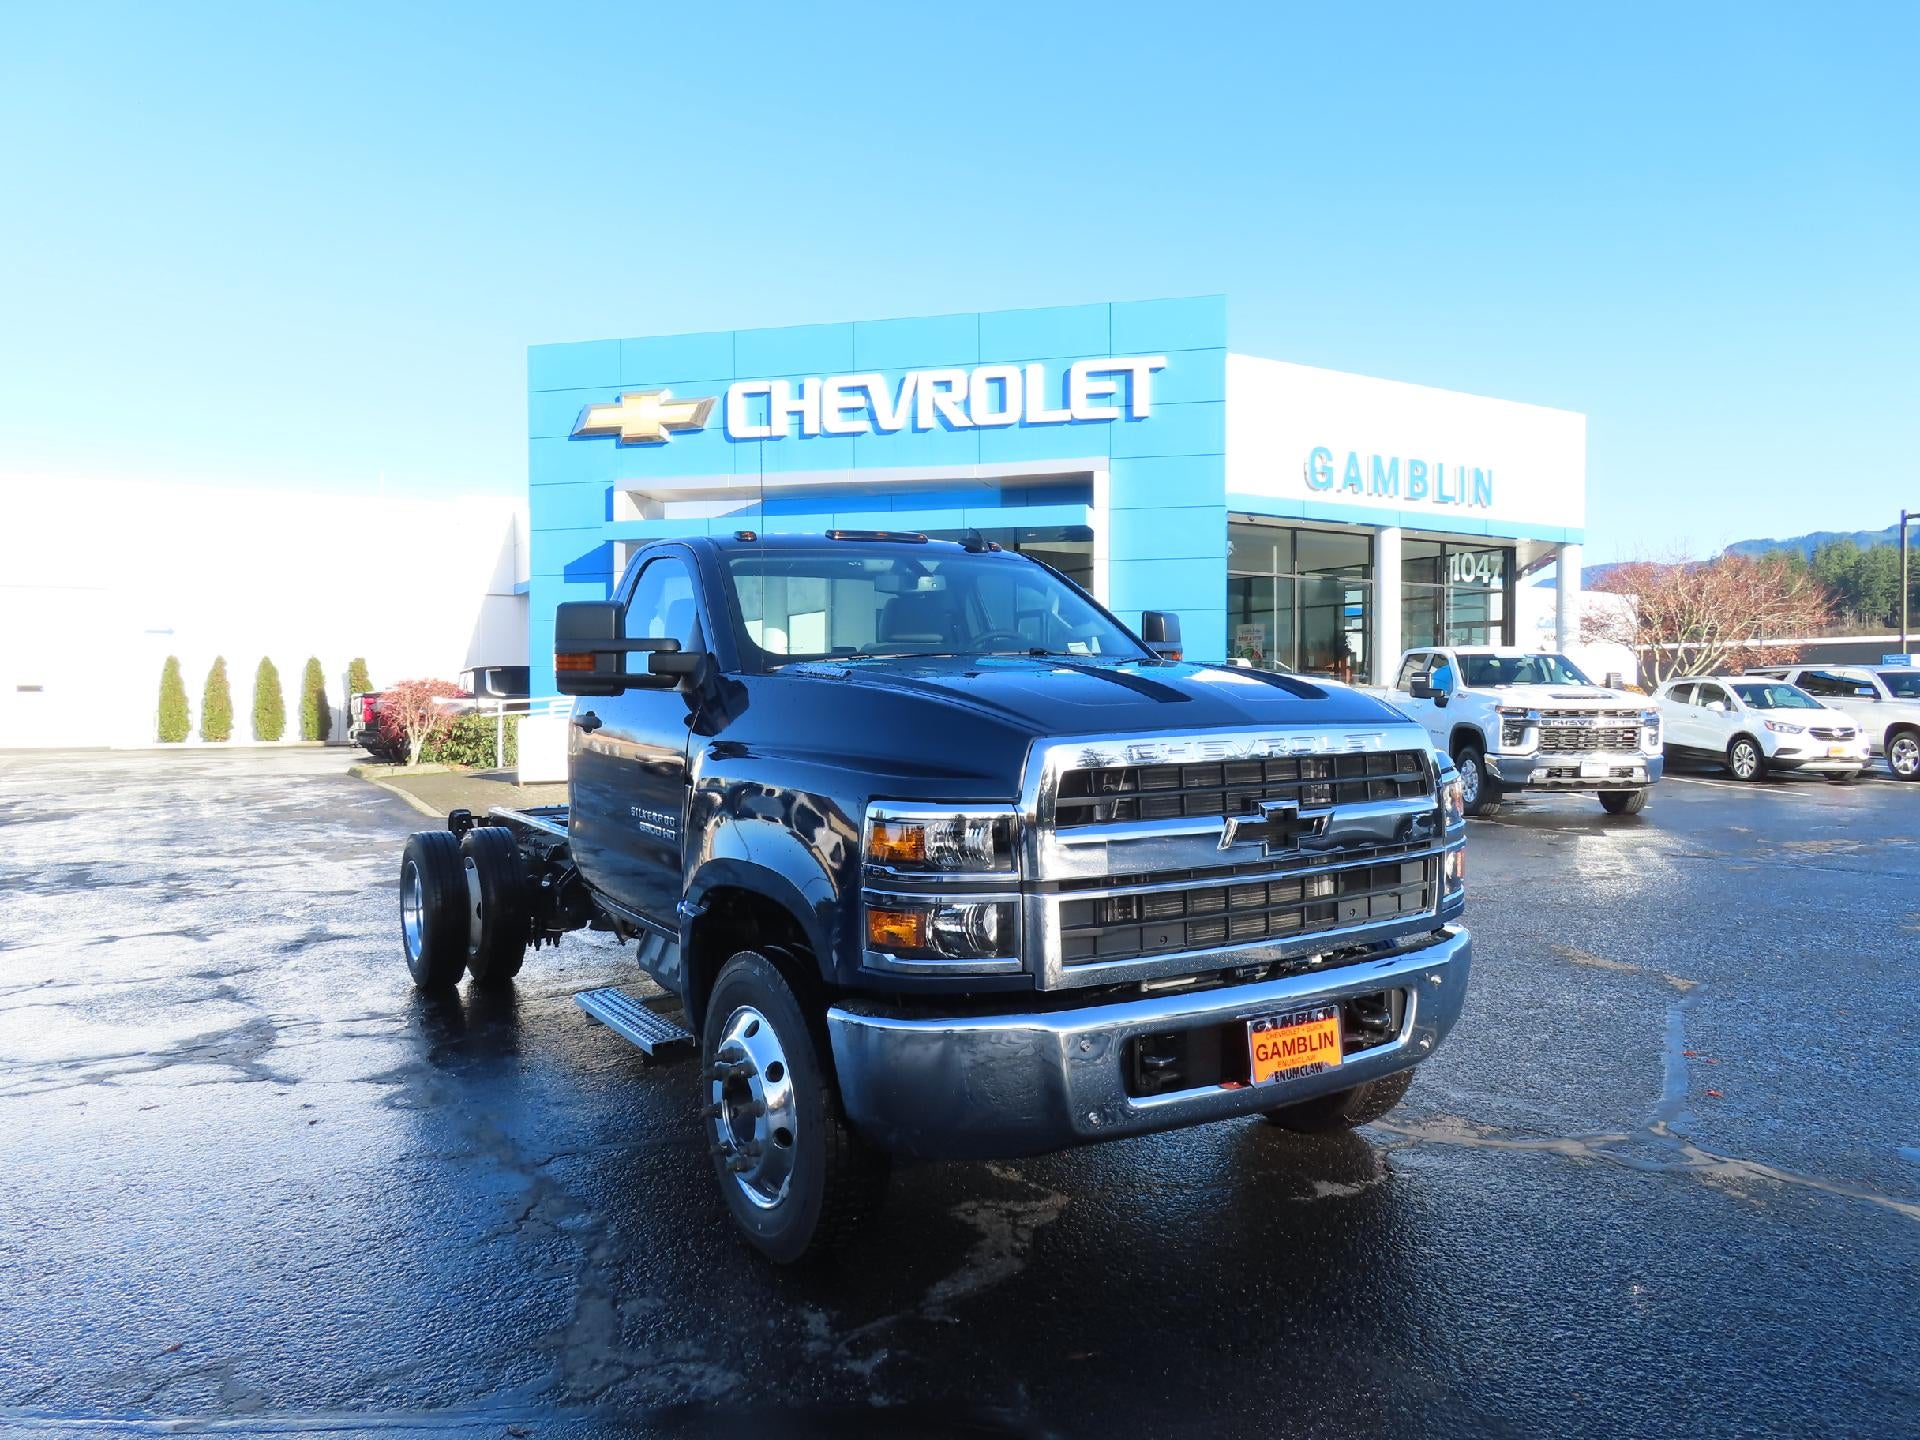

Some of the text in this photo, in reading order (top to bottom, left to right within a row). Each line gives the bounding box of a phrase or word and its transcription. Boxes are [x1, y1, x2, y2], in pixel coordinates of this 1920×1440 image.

[725, 355, 1168, 439] CHEVROLET
[1304, 446, 1493, 508] GAMBLIN
[1449, 551, 1504, 587] 1047
[1127, 732, 1387, 764] CHEVROLET
[1255, 1031, 1334, 1062] GAMBLIN
[1274, 1061, 1324, 1082] ENUMCLAW
